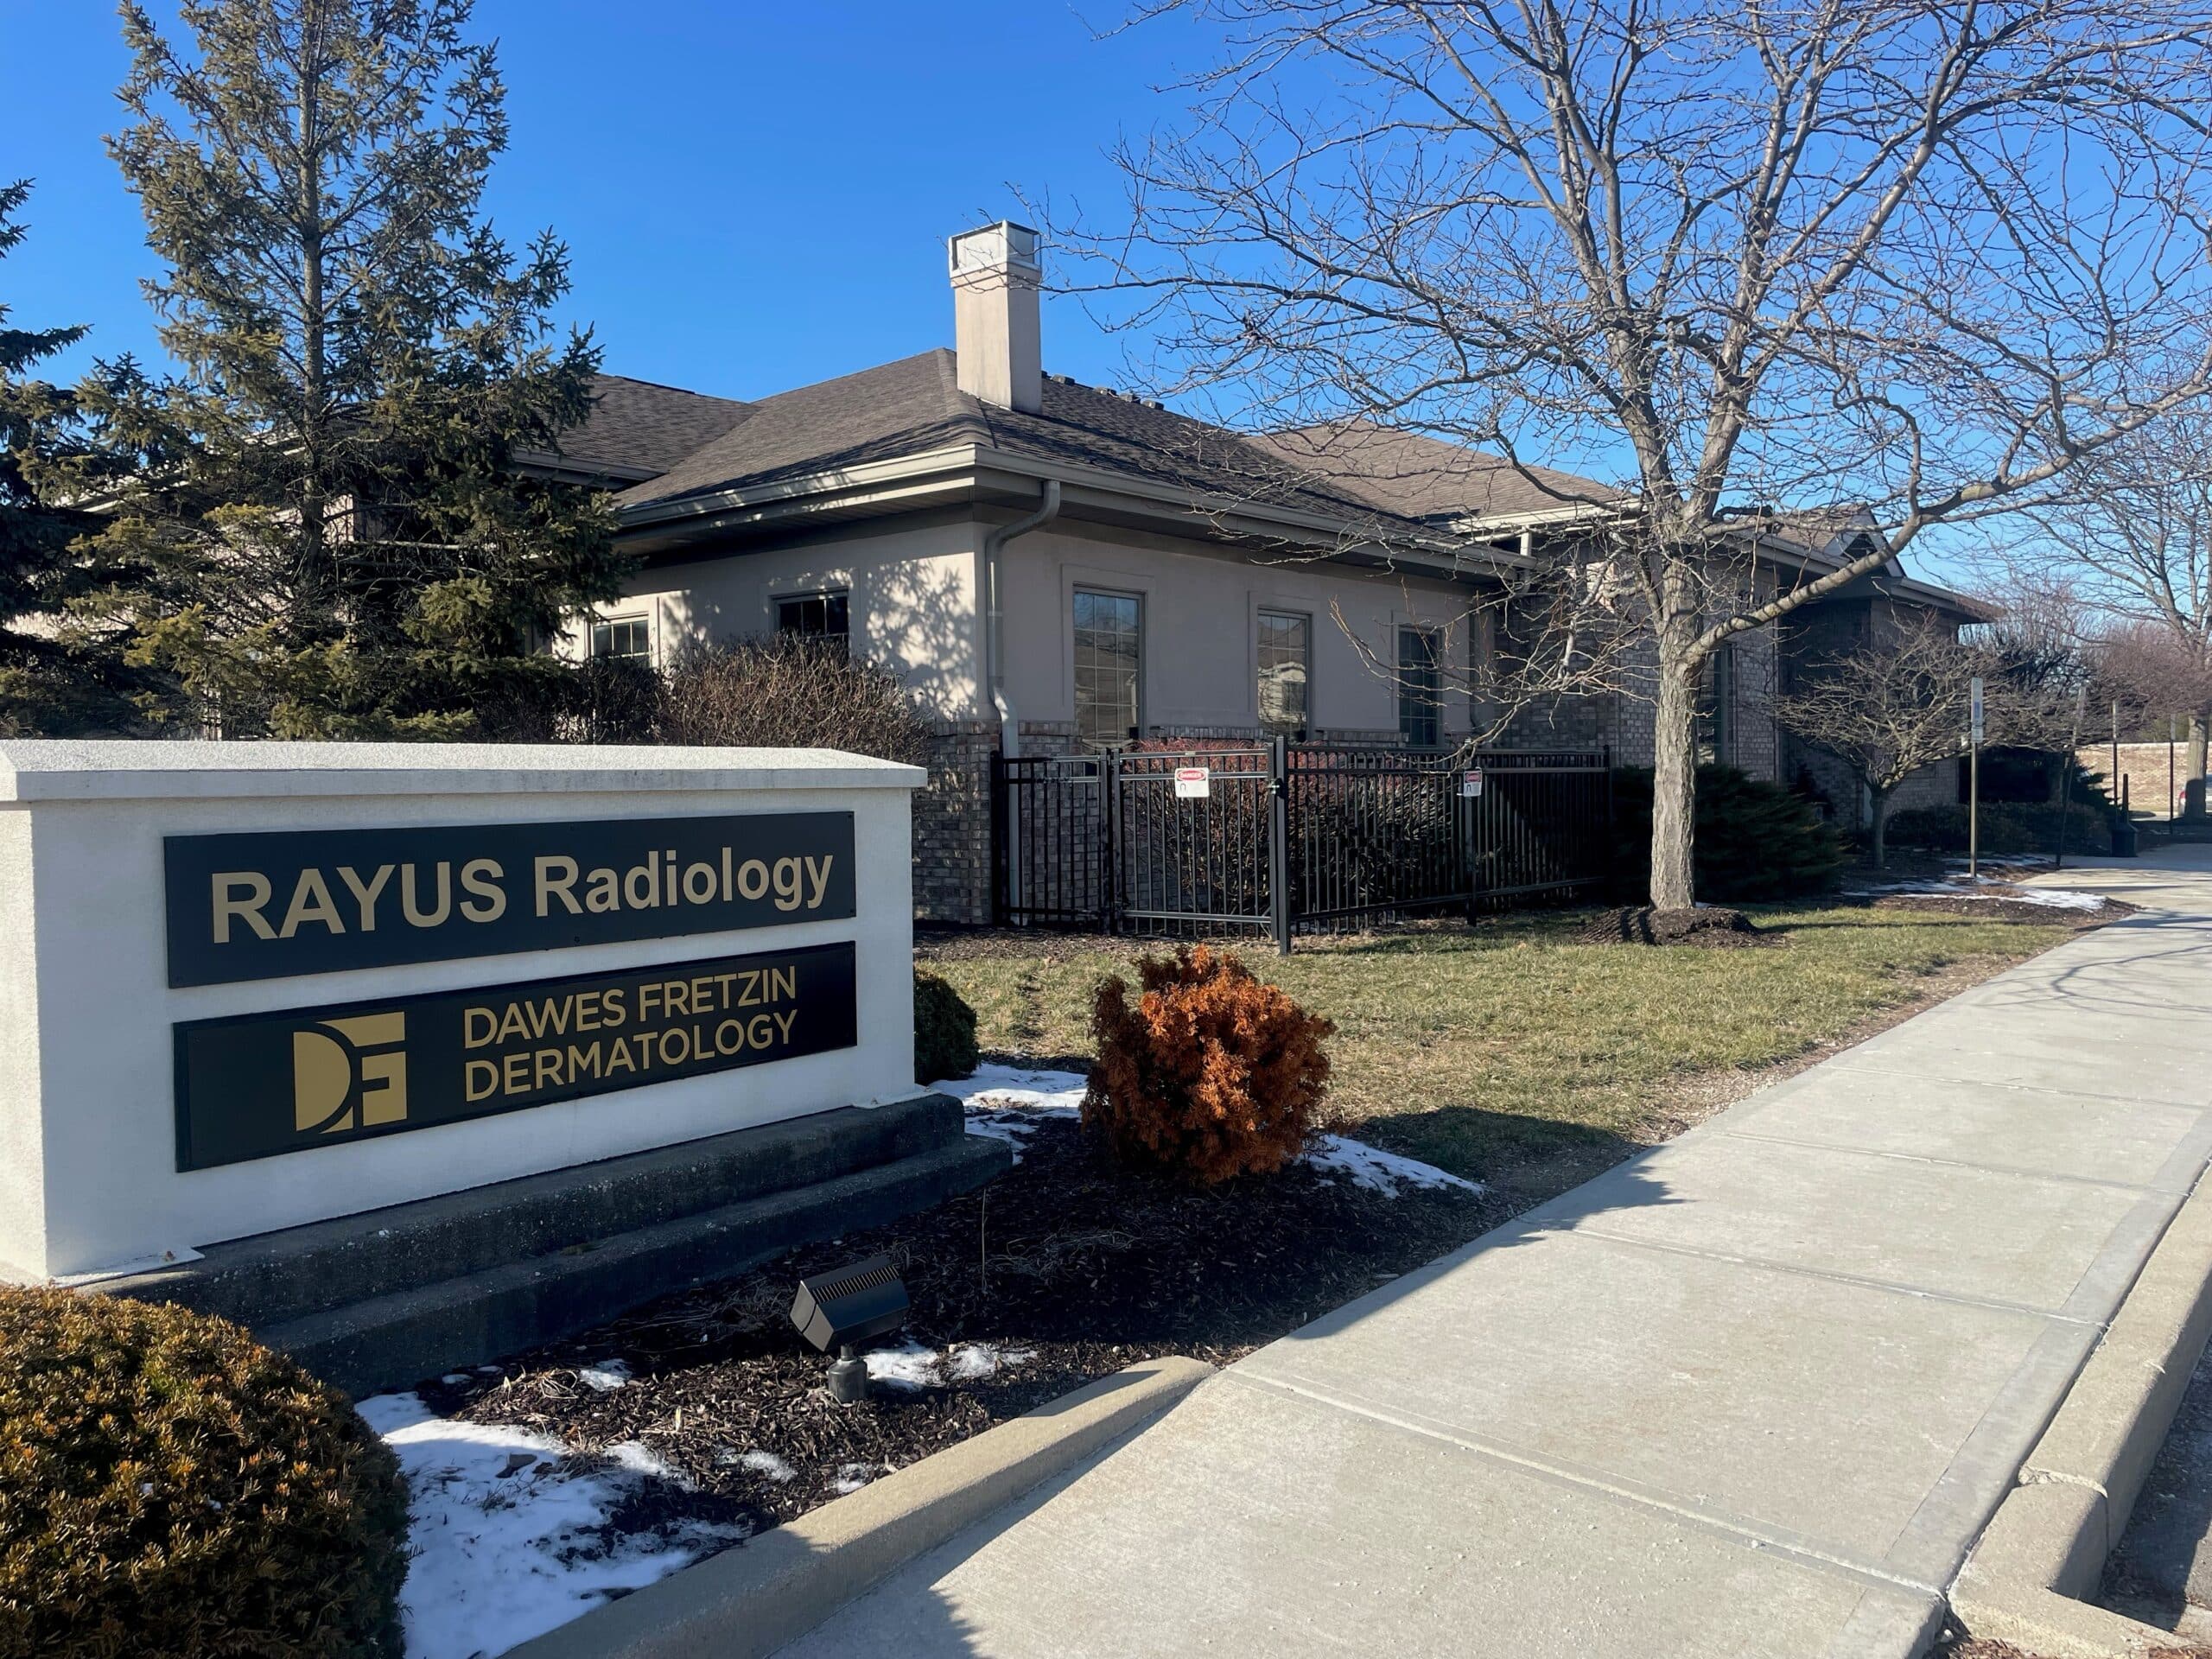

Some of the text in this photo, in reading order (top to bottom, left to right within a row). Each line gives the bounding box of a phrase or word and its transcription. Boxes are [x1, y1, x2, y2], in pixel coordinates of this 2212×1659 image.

[212, 848, 833, 944] RAYUS Radiology
[464, 965, 796, 1049] DAWES FRETZIN
[465, 1009, 797, 1102] DERMATOLOGY
